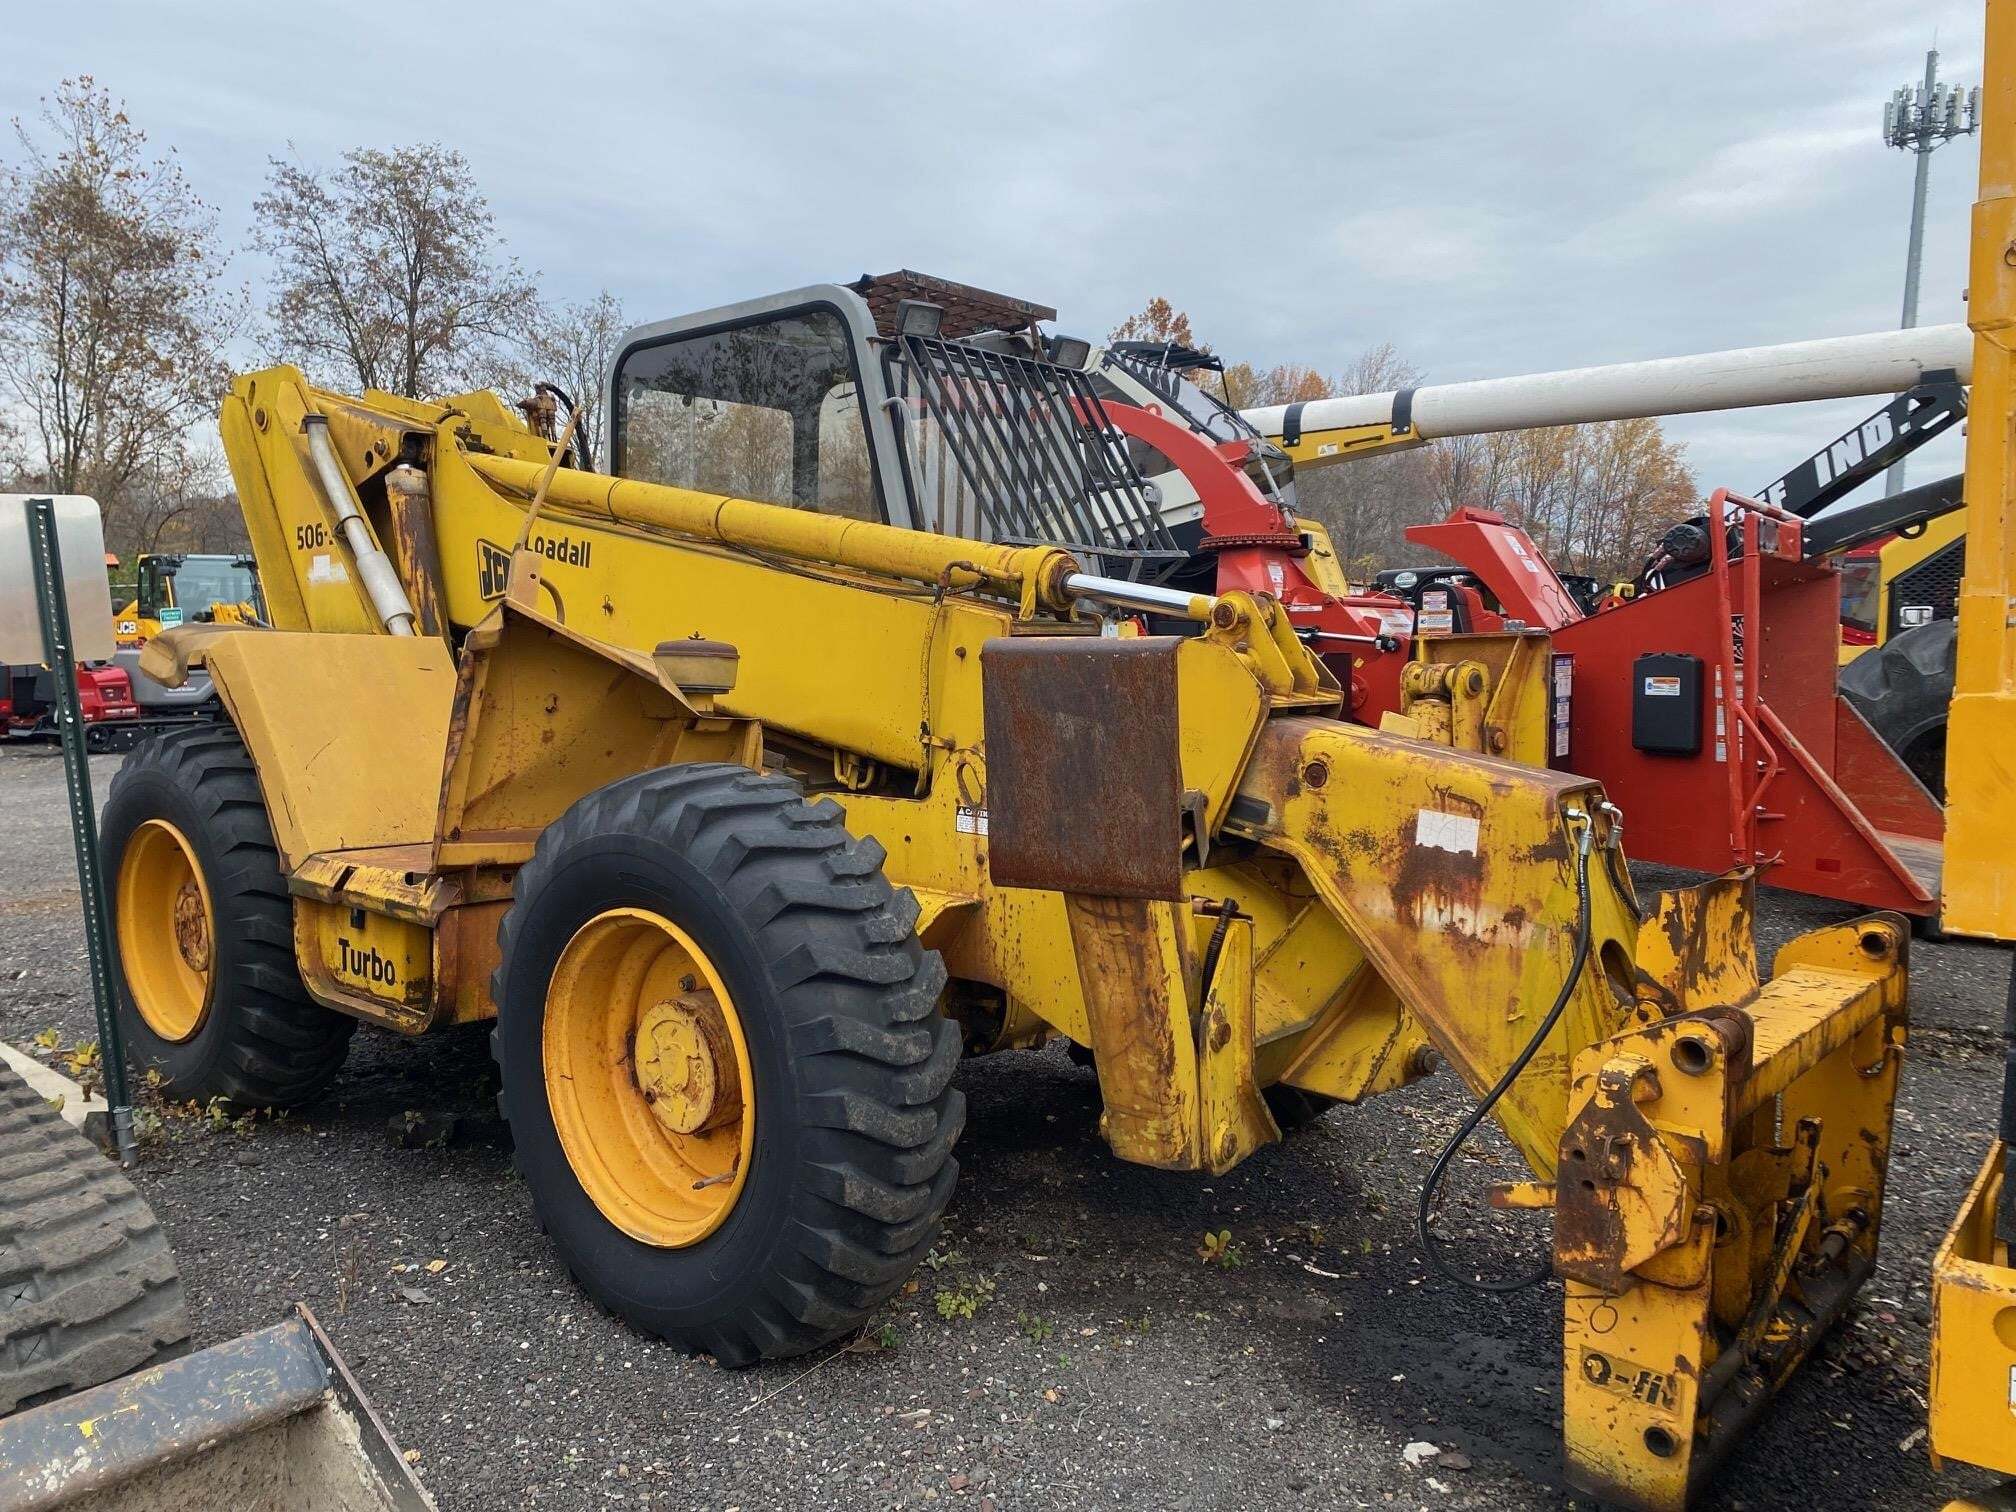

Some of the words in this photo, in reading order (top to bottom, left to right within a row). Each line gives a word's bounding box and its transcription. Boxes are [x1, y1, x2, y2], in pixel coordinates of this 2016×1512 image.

[296, 522, 334, 550] 506-
[117, 621, 137, 634] JCB
[338, 937, 396, 986] Turbo
